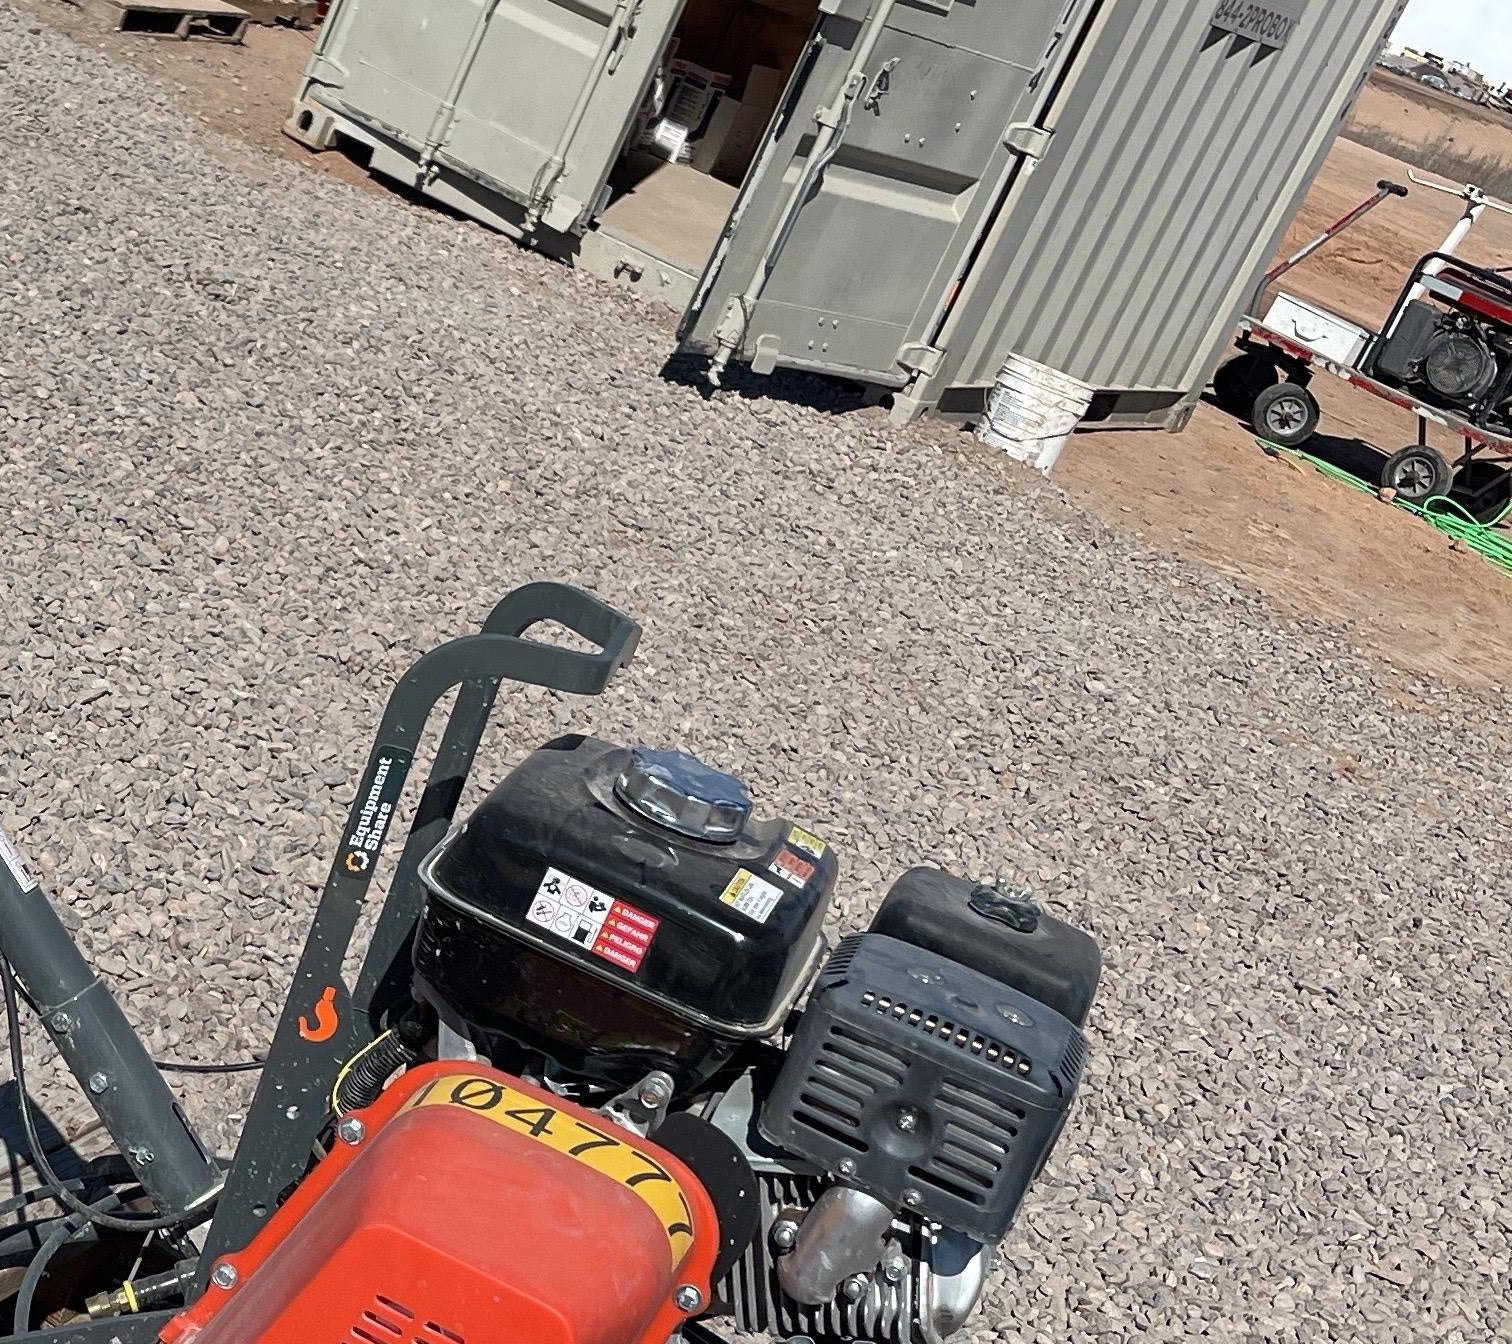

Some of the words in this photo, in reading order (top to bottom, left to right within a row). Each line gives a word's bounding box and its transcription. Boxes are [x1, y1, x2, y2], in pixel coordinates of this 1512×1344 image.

[348, 756, 393, 848] Equipment
[363, 802, 392, 851] Share
[621, 908, 656, 929] DANGER
[608, 933, 643, 955] PELIGRO
[602, 946, 637, 968] DANGER
